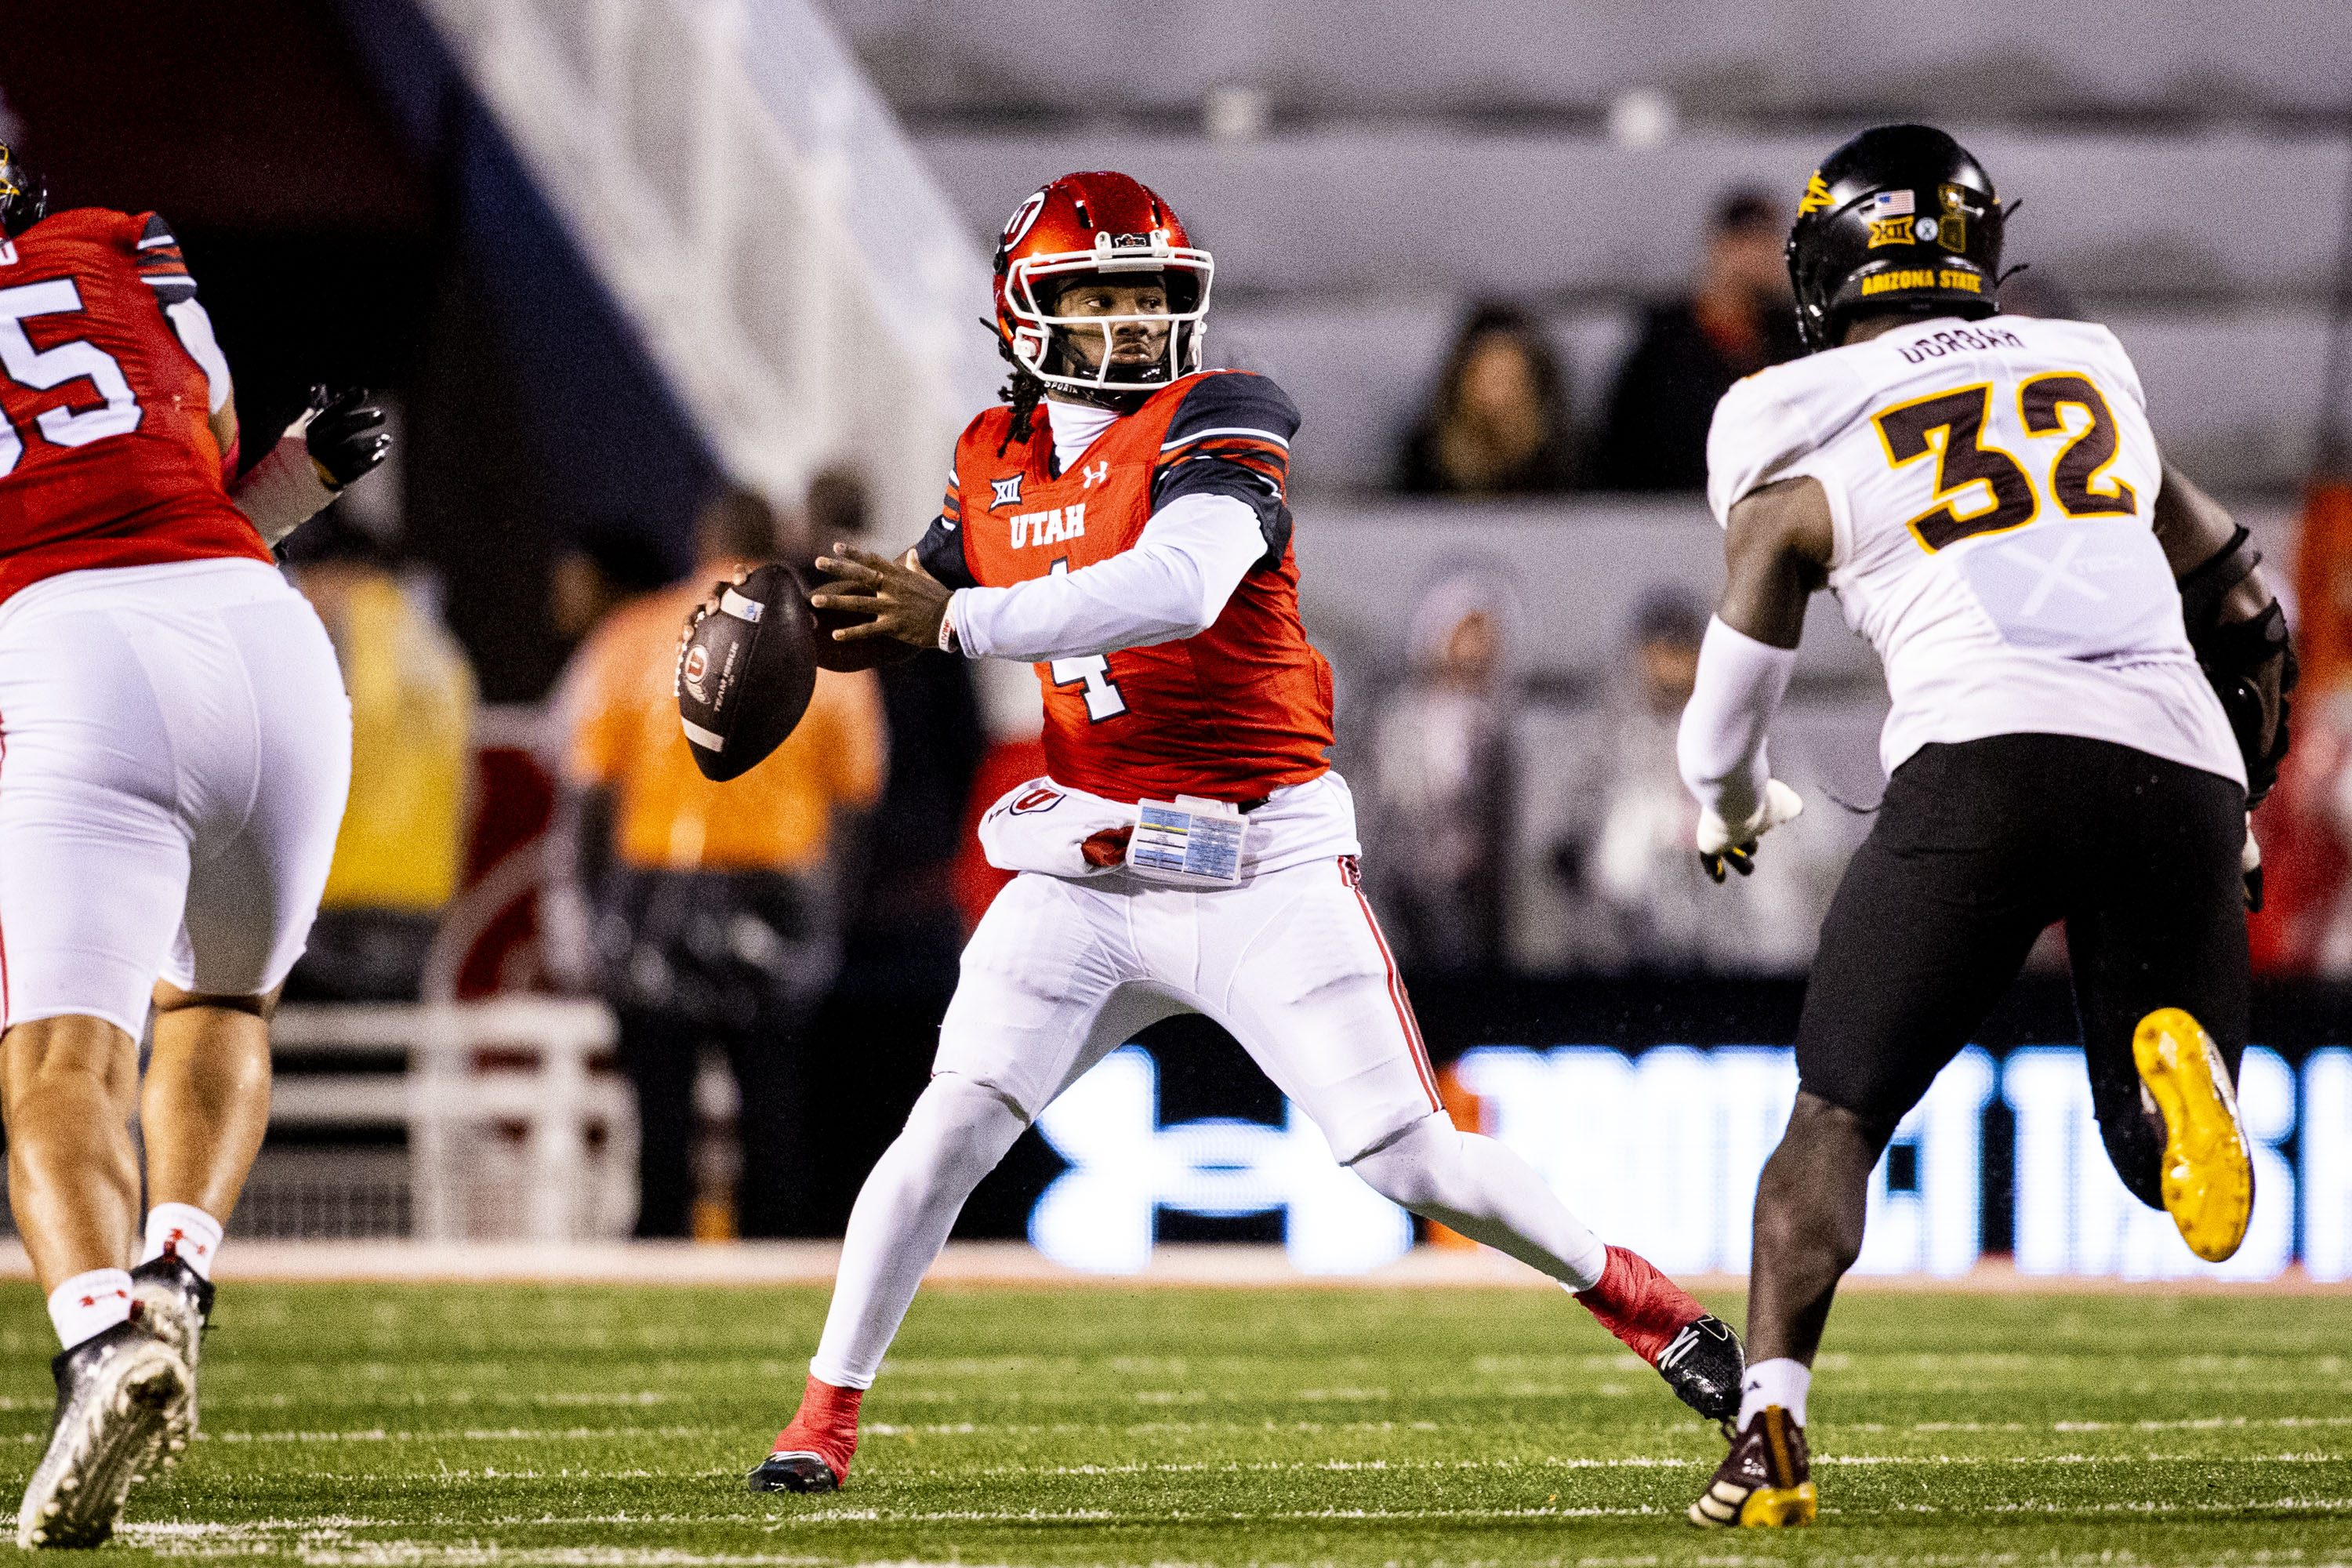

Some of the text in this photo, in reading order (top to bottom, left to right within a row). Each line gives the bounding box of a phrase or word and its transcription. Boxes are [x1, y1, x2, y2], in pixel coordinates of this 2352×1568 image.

[1862, 270, 1981, 296] ARIZONA STATE
[1898, 328, 2026, 363] DORBAH
[1870, 371, 2137, 554] 32
[990, 474, 1023, 510] XII
[1010, 503, 1085, 549] UTAH
